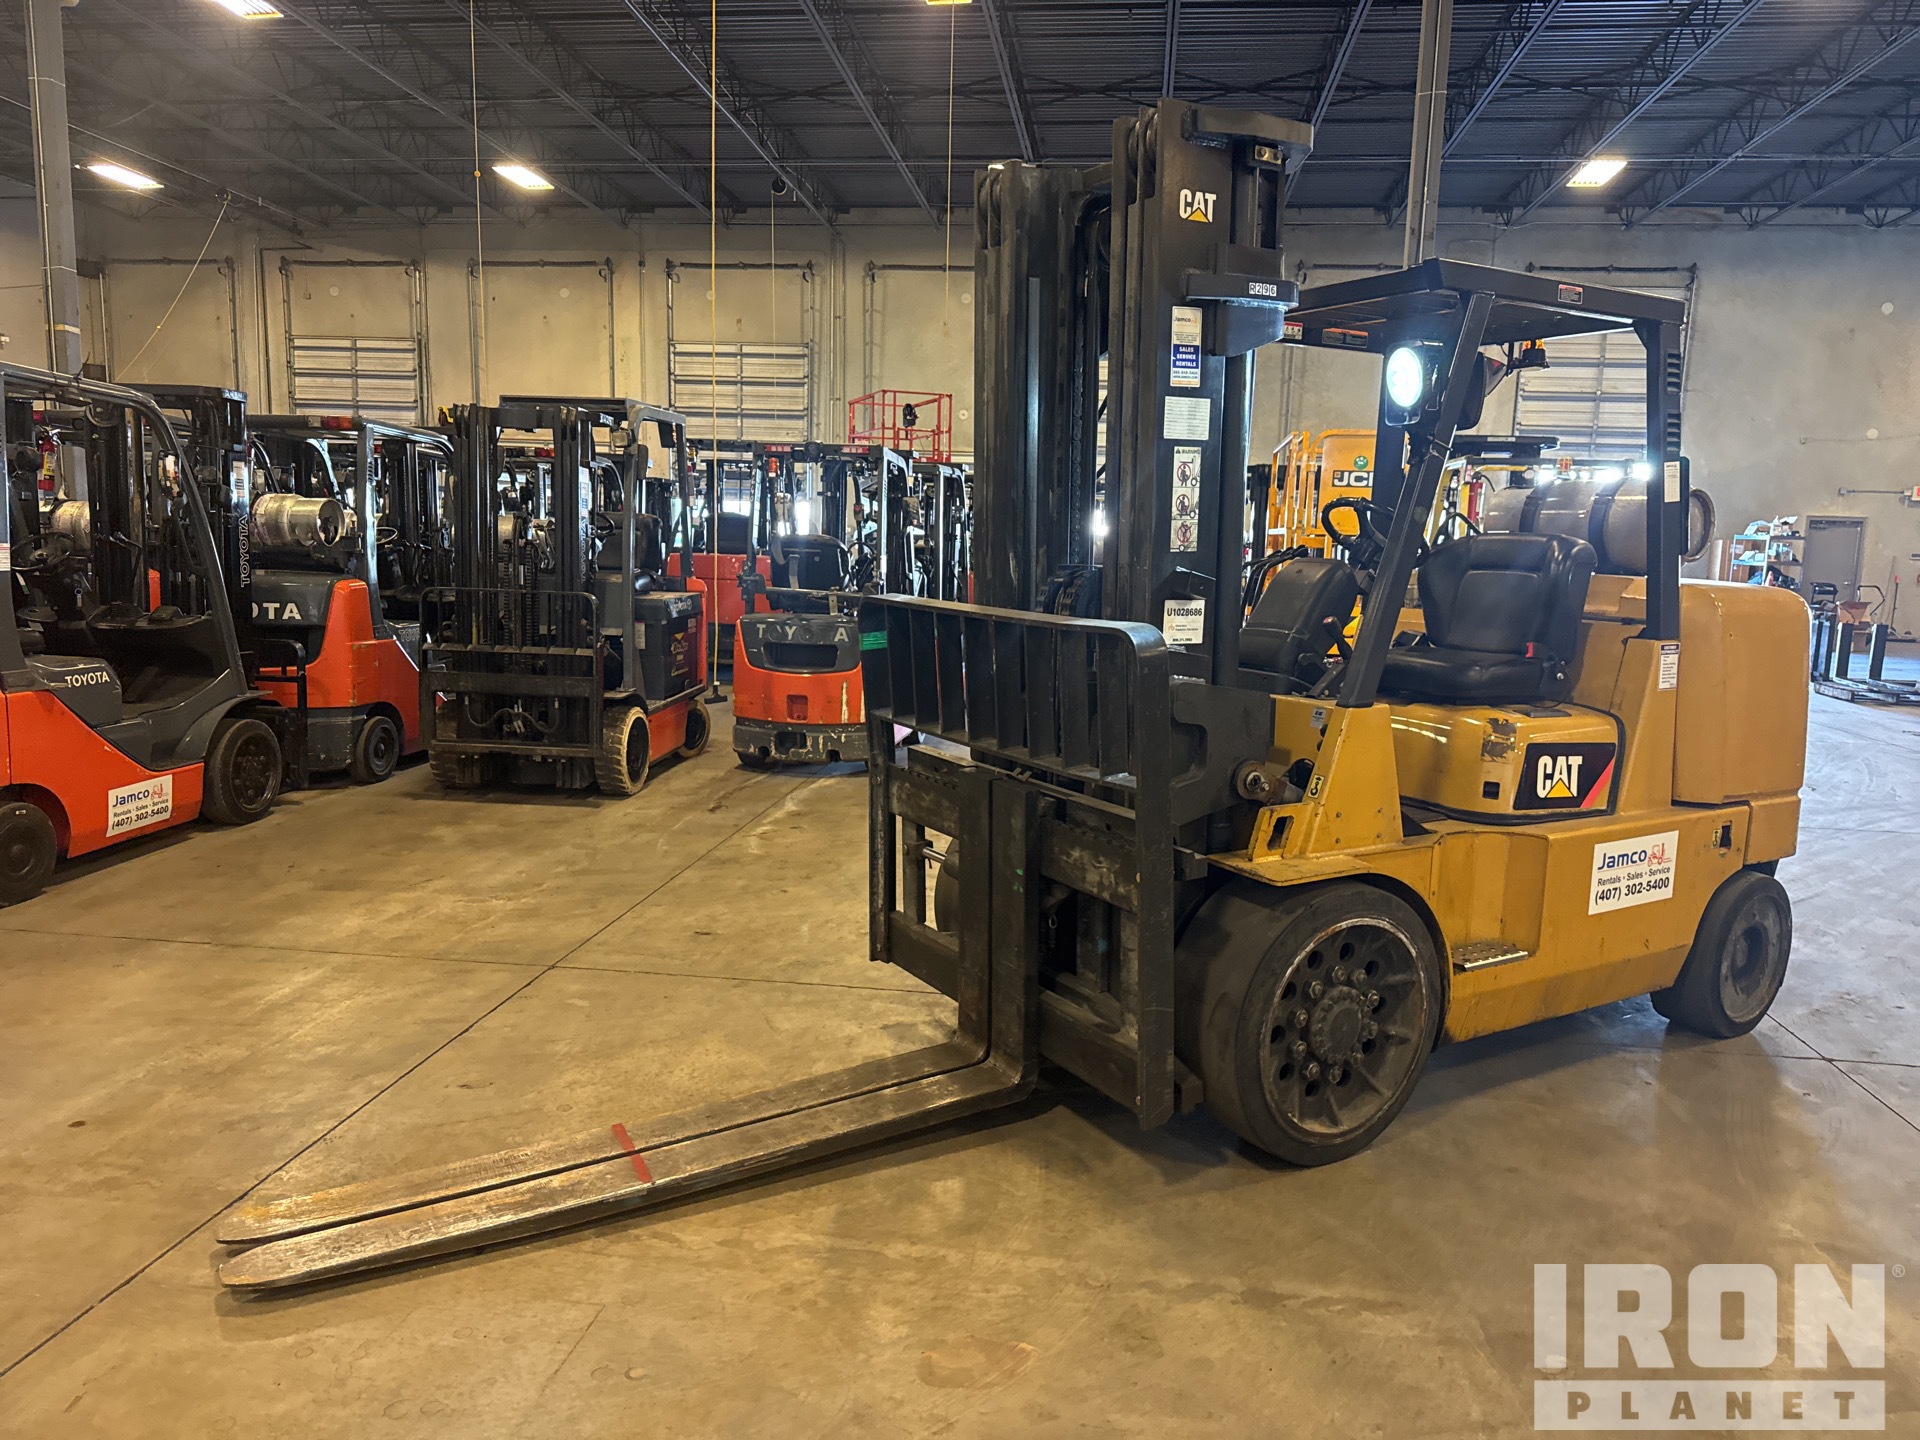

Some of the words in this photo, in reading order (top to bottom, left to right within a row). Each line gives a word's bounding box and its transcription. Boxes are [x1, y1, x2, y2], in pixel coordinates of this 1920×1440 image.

[1179, 188, 1217, 223] CAT
[1249, 282, 1276, 296] R296
[238, 514, 250, 588] TOYOTA
[1166, 607, 1202, 617] U1028686
[64, 671, 110, 688] TOYOTA
[1536, 755, 1583, 798] CAT
[112, 789, 150, 808] Jamco
[113, 808, 132, 818] Rentals
[135, 803, 148, 812] Sales
[152, 798, 169, 808] Service
[112, 815, 133, 830] (407)
[134, 805, 169, 823] 302-5400
[1597, 849, 1648, 871] Jamco
[1597, 875, 1621, 887] Rentals
[1626, 872, 1644, 882] Sales
[1648, 866, 1671, 877] Service
[1594, 887, 1621, 905] (407)
[1624, 876, 1670, 897] 302-5400
